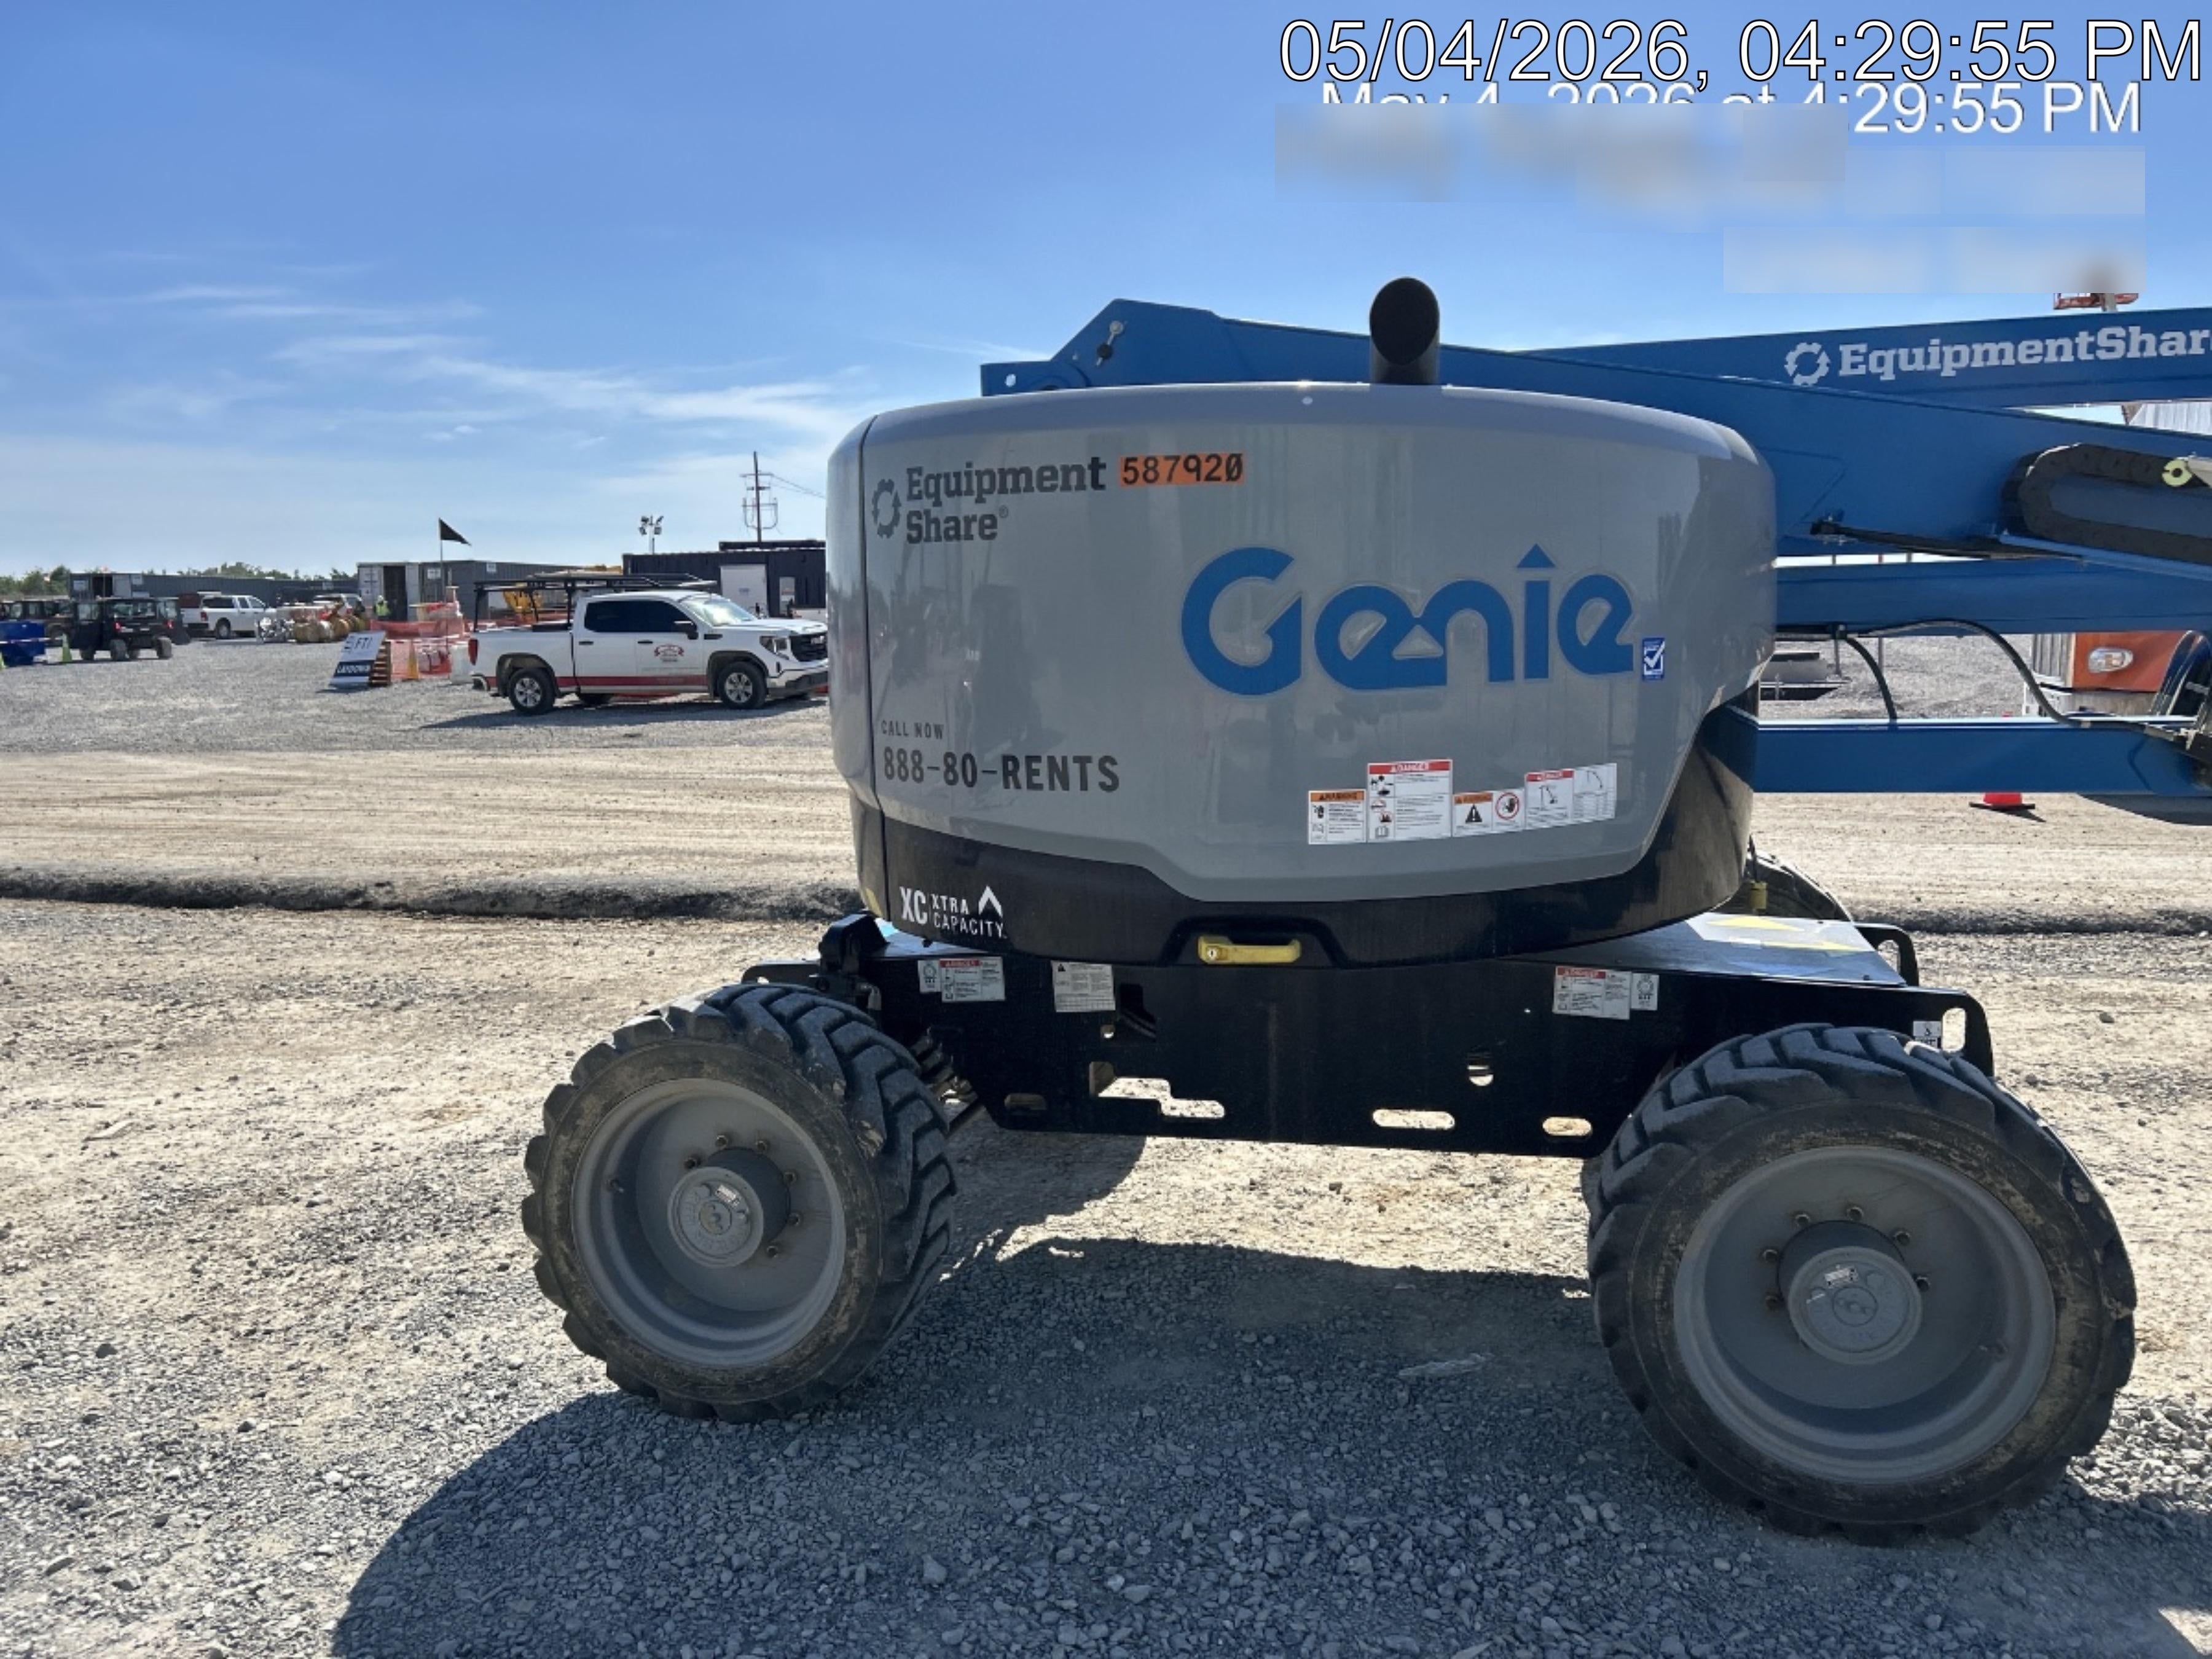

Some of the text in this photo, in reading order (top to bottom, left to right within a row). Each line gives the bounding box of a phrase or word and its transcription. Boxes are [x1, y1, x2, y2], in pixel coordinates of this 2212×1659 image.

[1838, 326, 2212, 381] EquipmentShar
[906, 457, 1106, 508] Equipment
[1123, 453, 1244, 485] 587920
[1181, 543, 1635, 696] Genie
[881, 720, 944, 740] CALL NOW
[884, 746, 1120, 793] 888-80-RENTS
[900, 886, 928, 924] XC
[931, 893, 969, 915] XTRA
[933, 912, 1004, 939] CAPACITY
